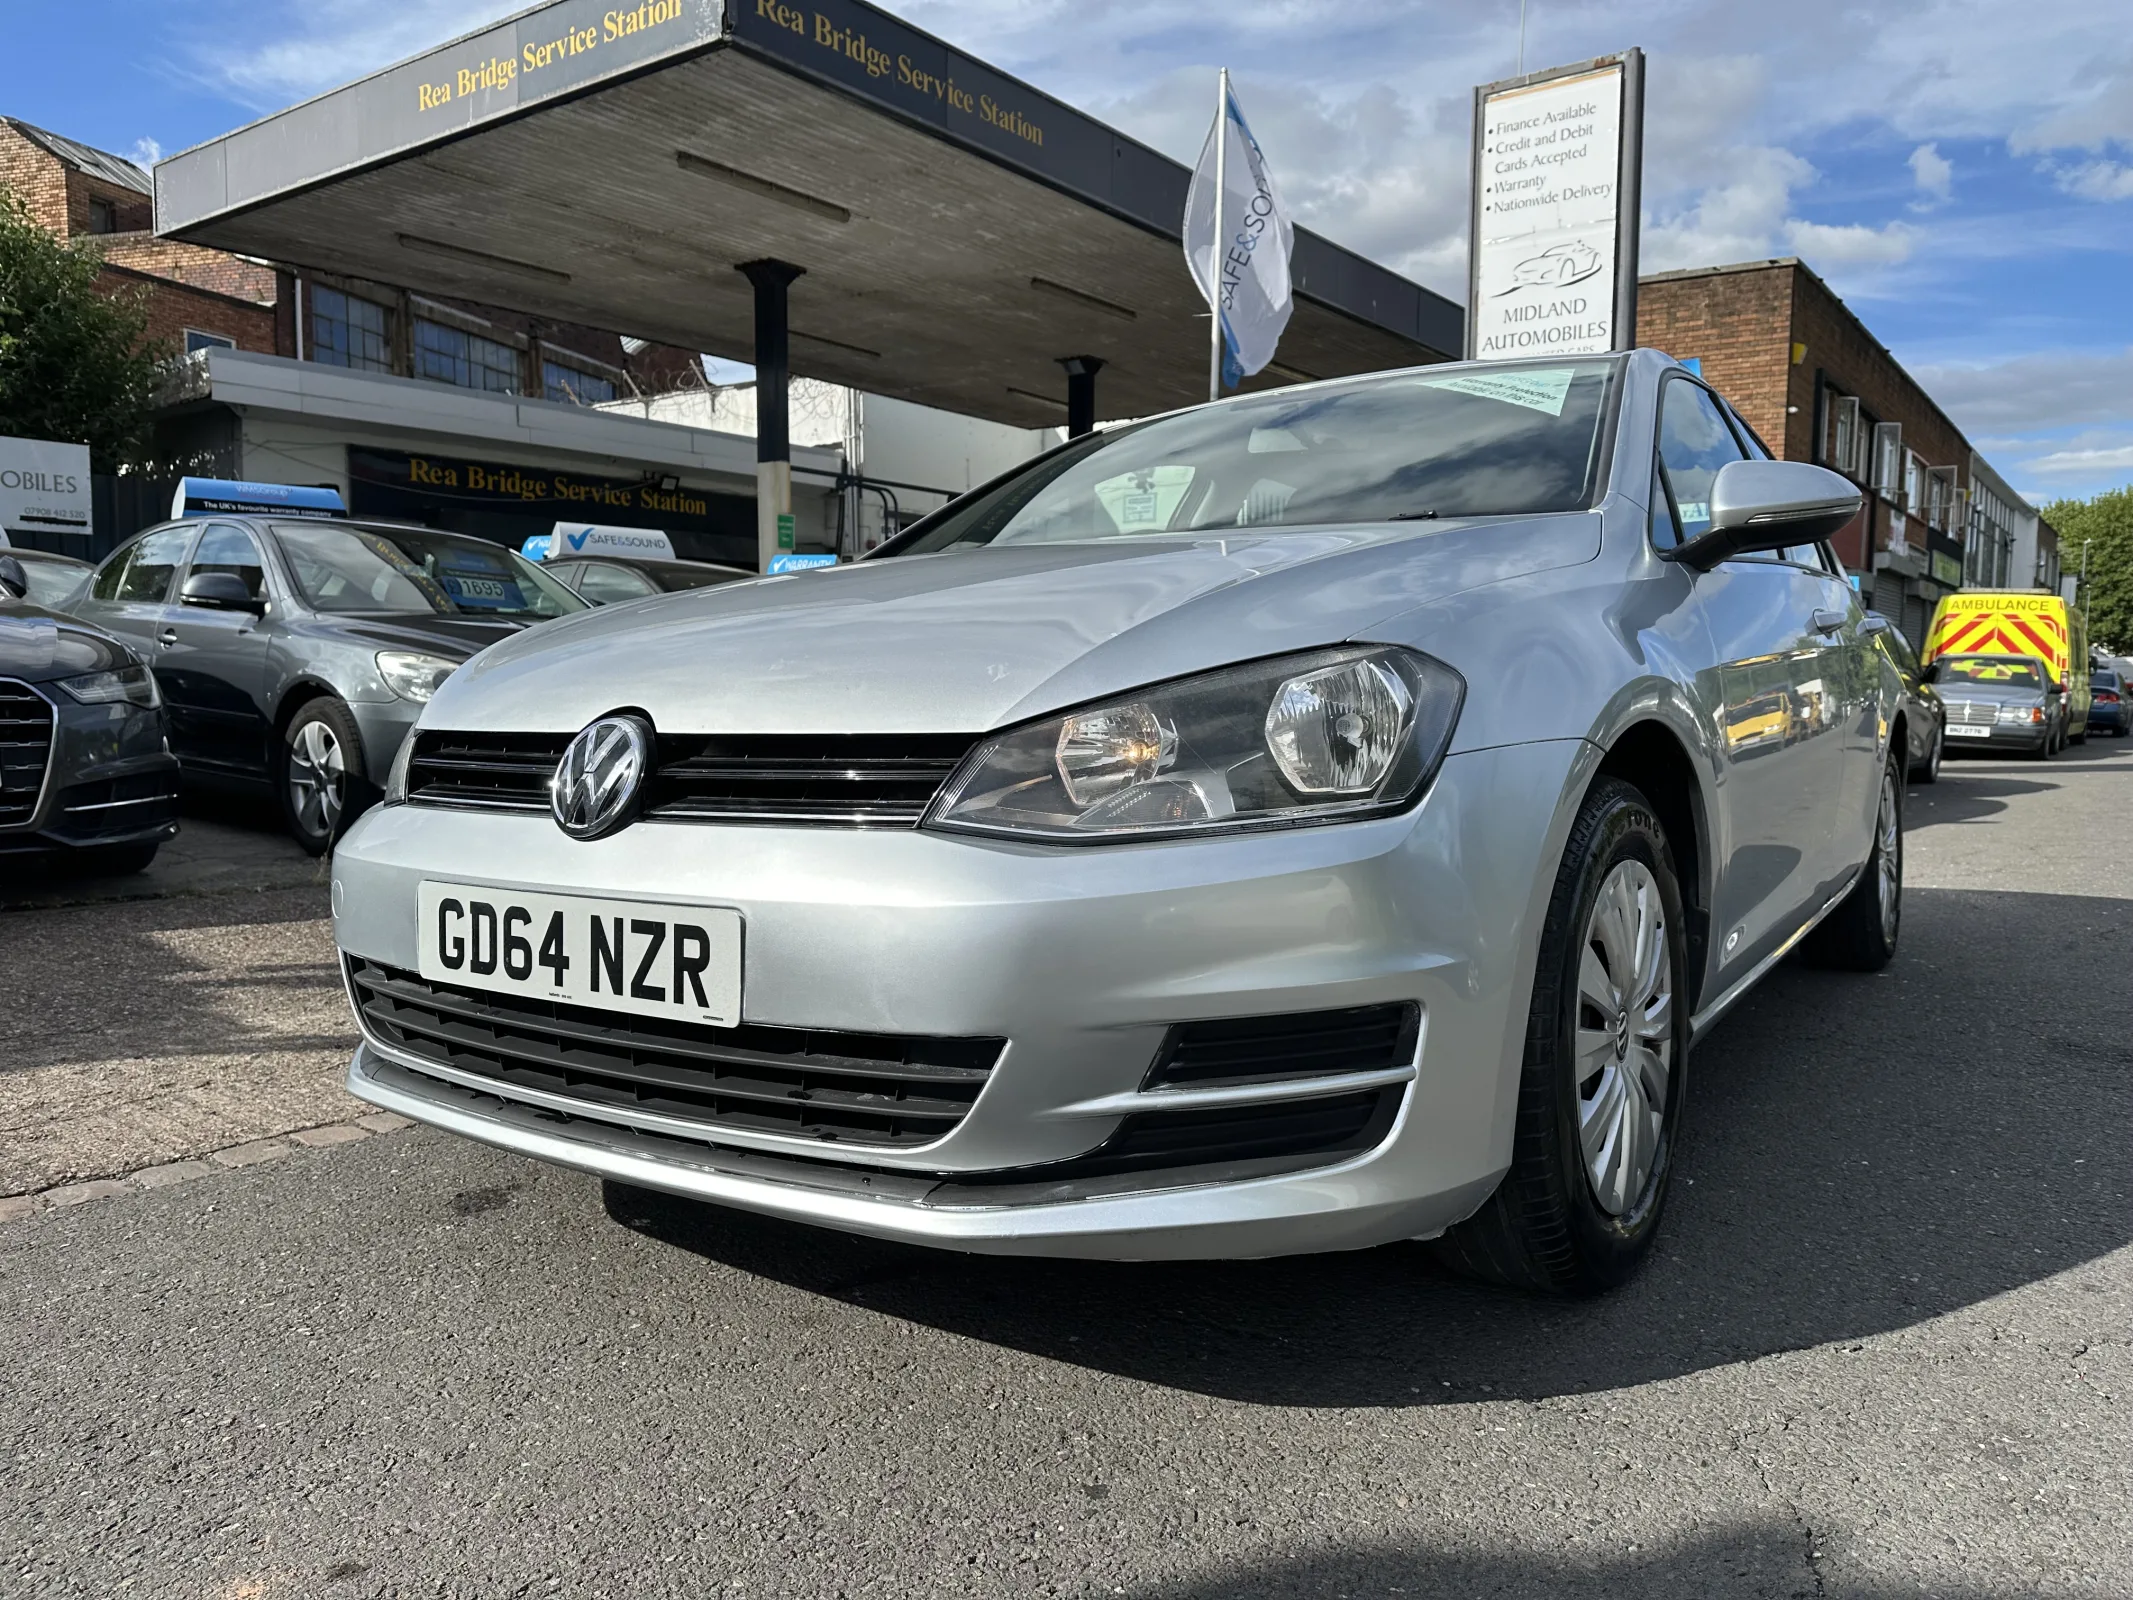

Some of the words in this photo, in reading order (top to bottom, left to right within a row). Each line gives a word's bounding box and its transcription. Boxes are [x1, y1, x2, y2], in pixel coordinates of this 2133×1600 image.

[419, 82, 451, 111] Rea
[457, 57, 518, 90] Bridge
[522, 25, 597, 73] Service
[602, 0, 683, 43] Station
[755, 0, 804, 35] Rea
[814, 12, 891, 77] Bridge
[897, 54, 974, 113] Service
[980, 94, 1043, 146] Station
[1496, 117, 1540, 135] Finance
[1543, 102, 1597, 125] Available
[1495, 135, 1531, 154] Credit
[1534, 130, 1556, 147] and
[1560, 124, 1594, 141] Debit
[1495, 153, 1528, 174] Cards
[1531, 144, 1588, 166] Accepted
[1493, 191, 1559, 213] Nationwide
[1562, 183, 1613, 201] Delivery
[1494, 175, 1547, 194] Warranty
[1503, 298, 1587, 324] MIDLAND
[1482, 321, 1608, 352] AUTOMOBILES
[409, 458, 458, 488] Rea
[466, 466, 547, 501] Bridge
[553, 476, 632, 506] Service
[640, 487, 707, 516] Station
[24, 506, 51, 516] 07908
[53, 508, 67, 517] 412
[203, 500, 218, 509] The
[219, 502, 237, 511] UK's
[237, 503, 269, 513] favourite
[270, 507, 300, 517] warranty
[301, 510, 332, 519] company
[589, 533, 666, 549] SAFE&SOUND
[1950, 599, 2050, 611] AMBULANCE
[438, 897, 570, 988] GD64
[590, 914, 711, 1009] NZR
